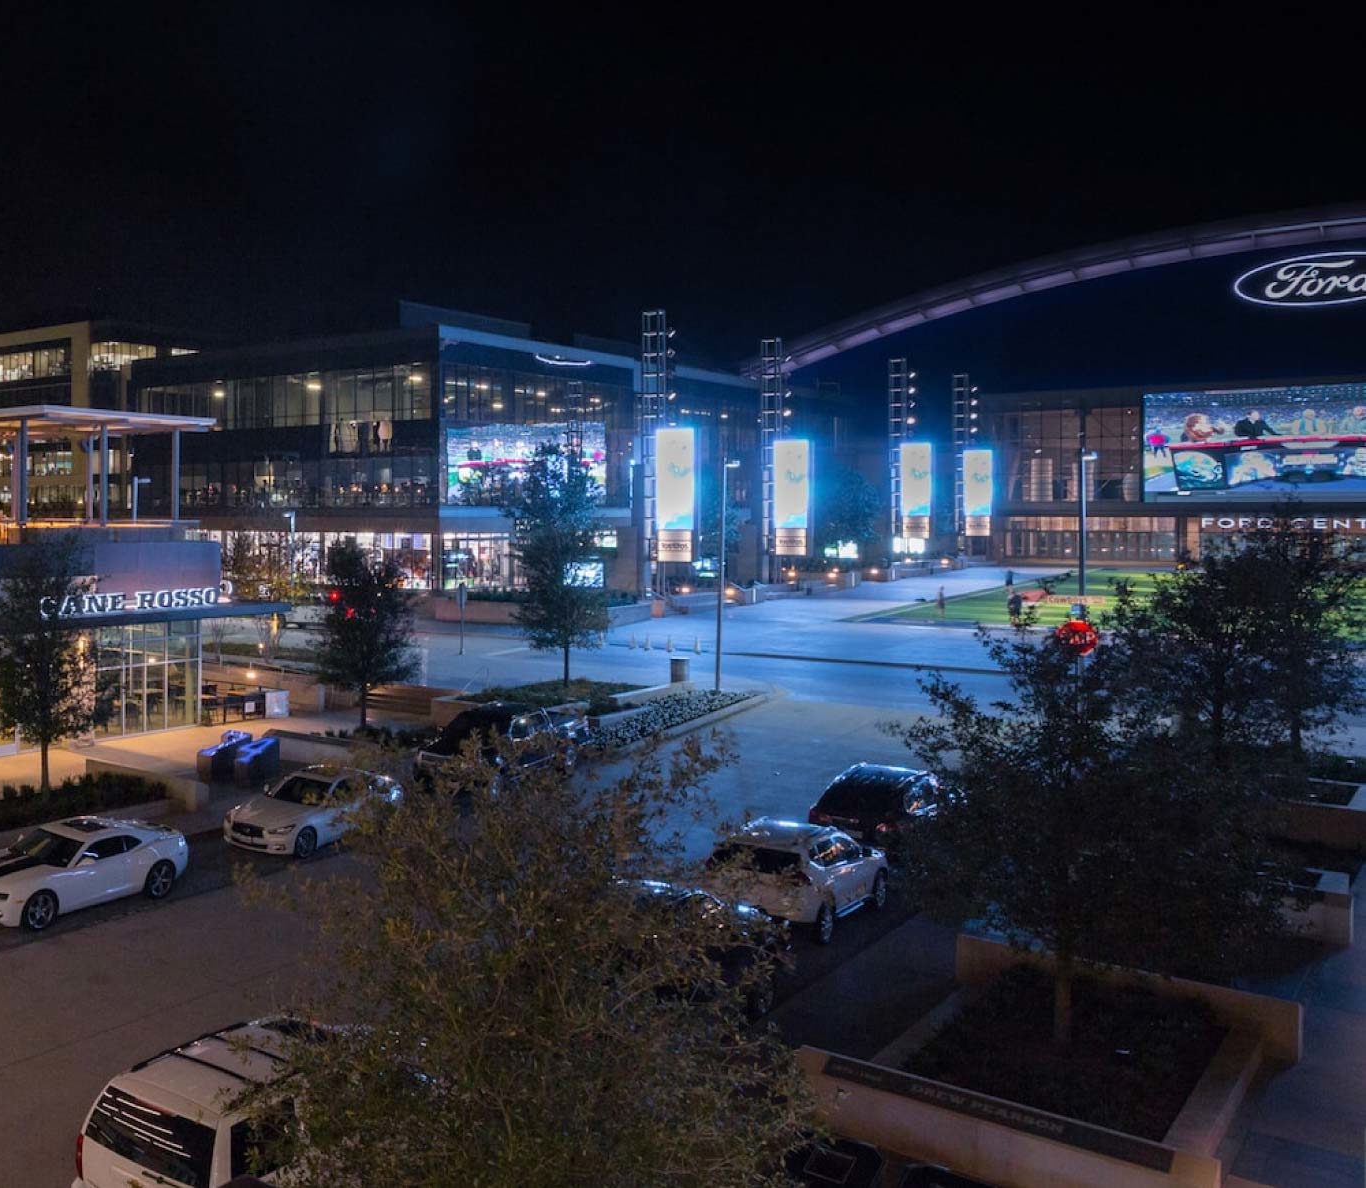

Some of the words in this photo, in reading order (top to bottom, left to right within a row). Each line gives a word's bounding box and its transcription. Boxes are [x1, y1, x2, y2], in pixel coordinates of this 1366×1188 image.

[1201, 517, 1274, 529] FORD
[40, 592, 127, 620] CANE
[136, 587, 217, 610] ROSSO
